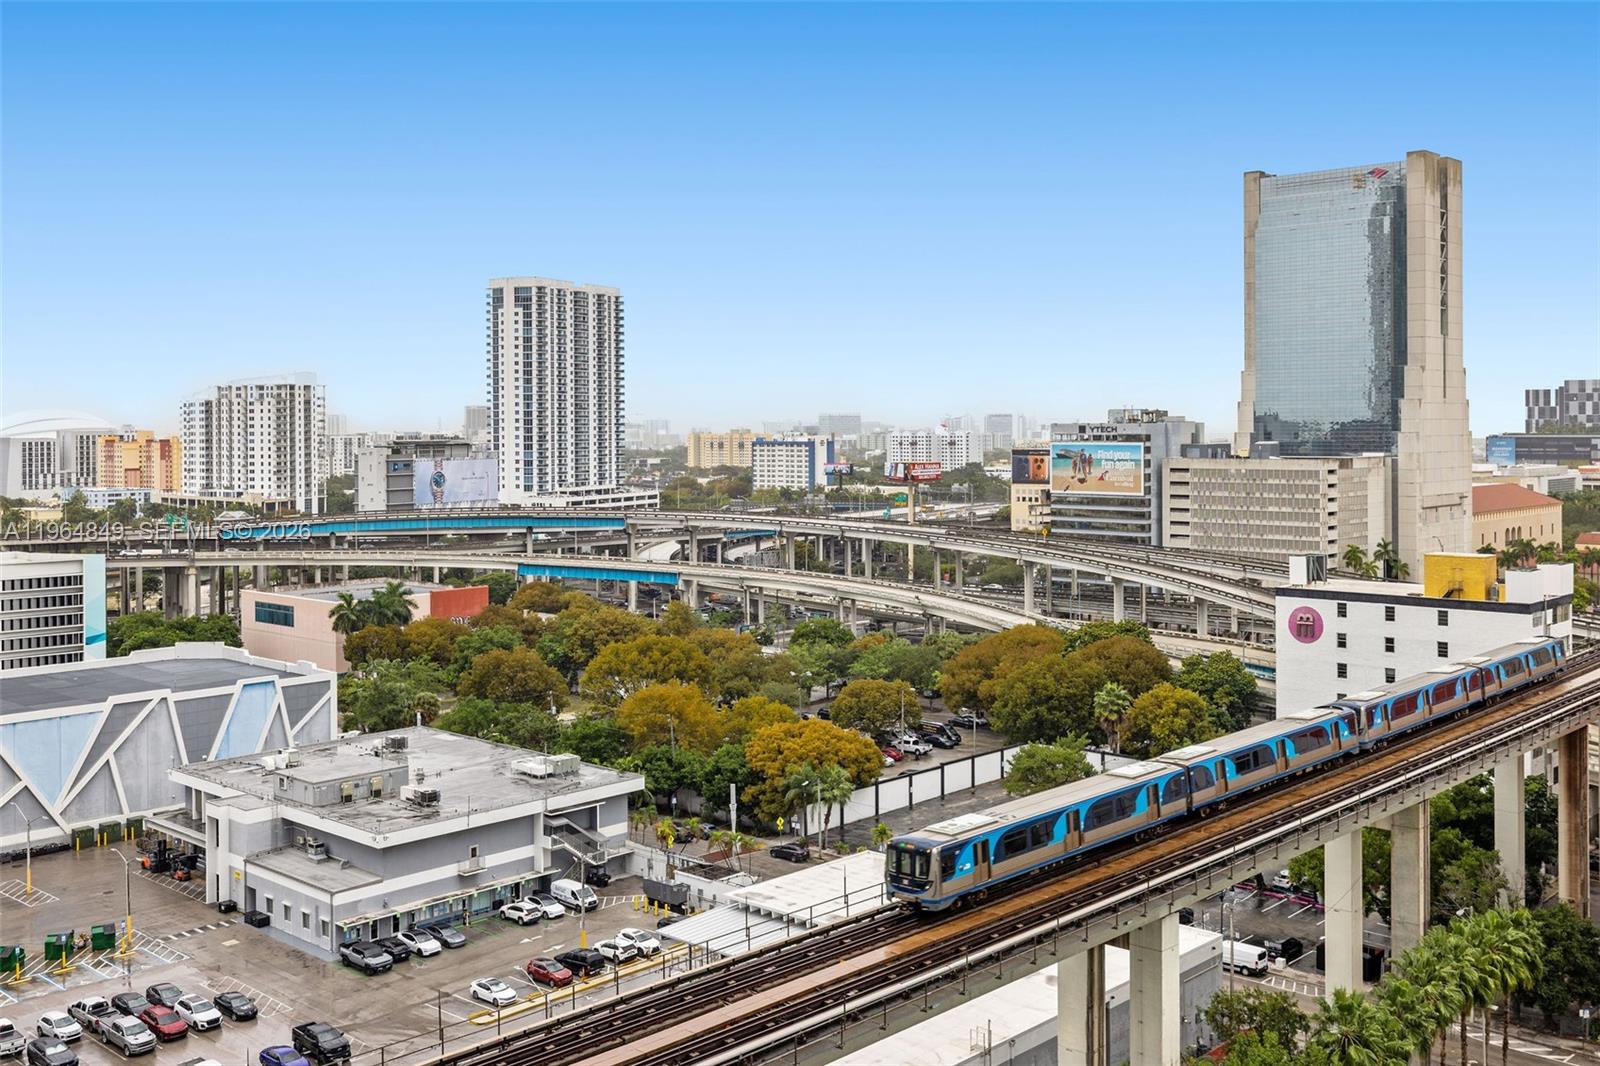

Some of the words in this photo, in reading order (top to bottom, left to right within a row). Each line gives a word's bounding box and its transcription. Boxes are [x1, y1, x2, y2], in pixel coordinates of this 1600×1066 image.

[1098, 450, 1113, 459] Find
[1101, 459, 1114, 469] fun
[1114, 460, 1136, 471] again
